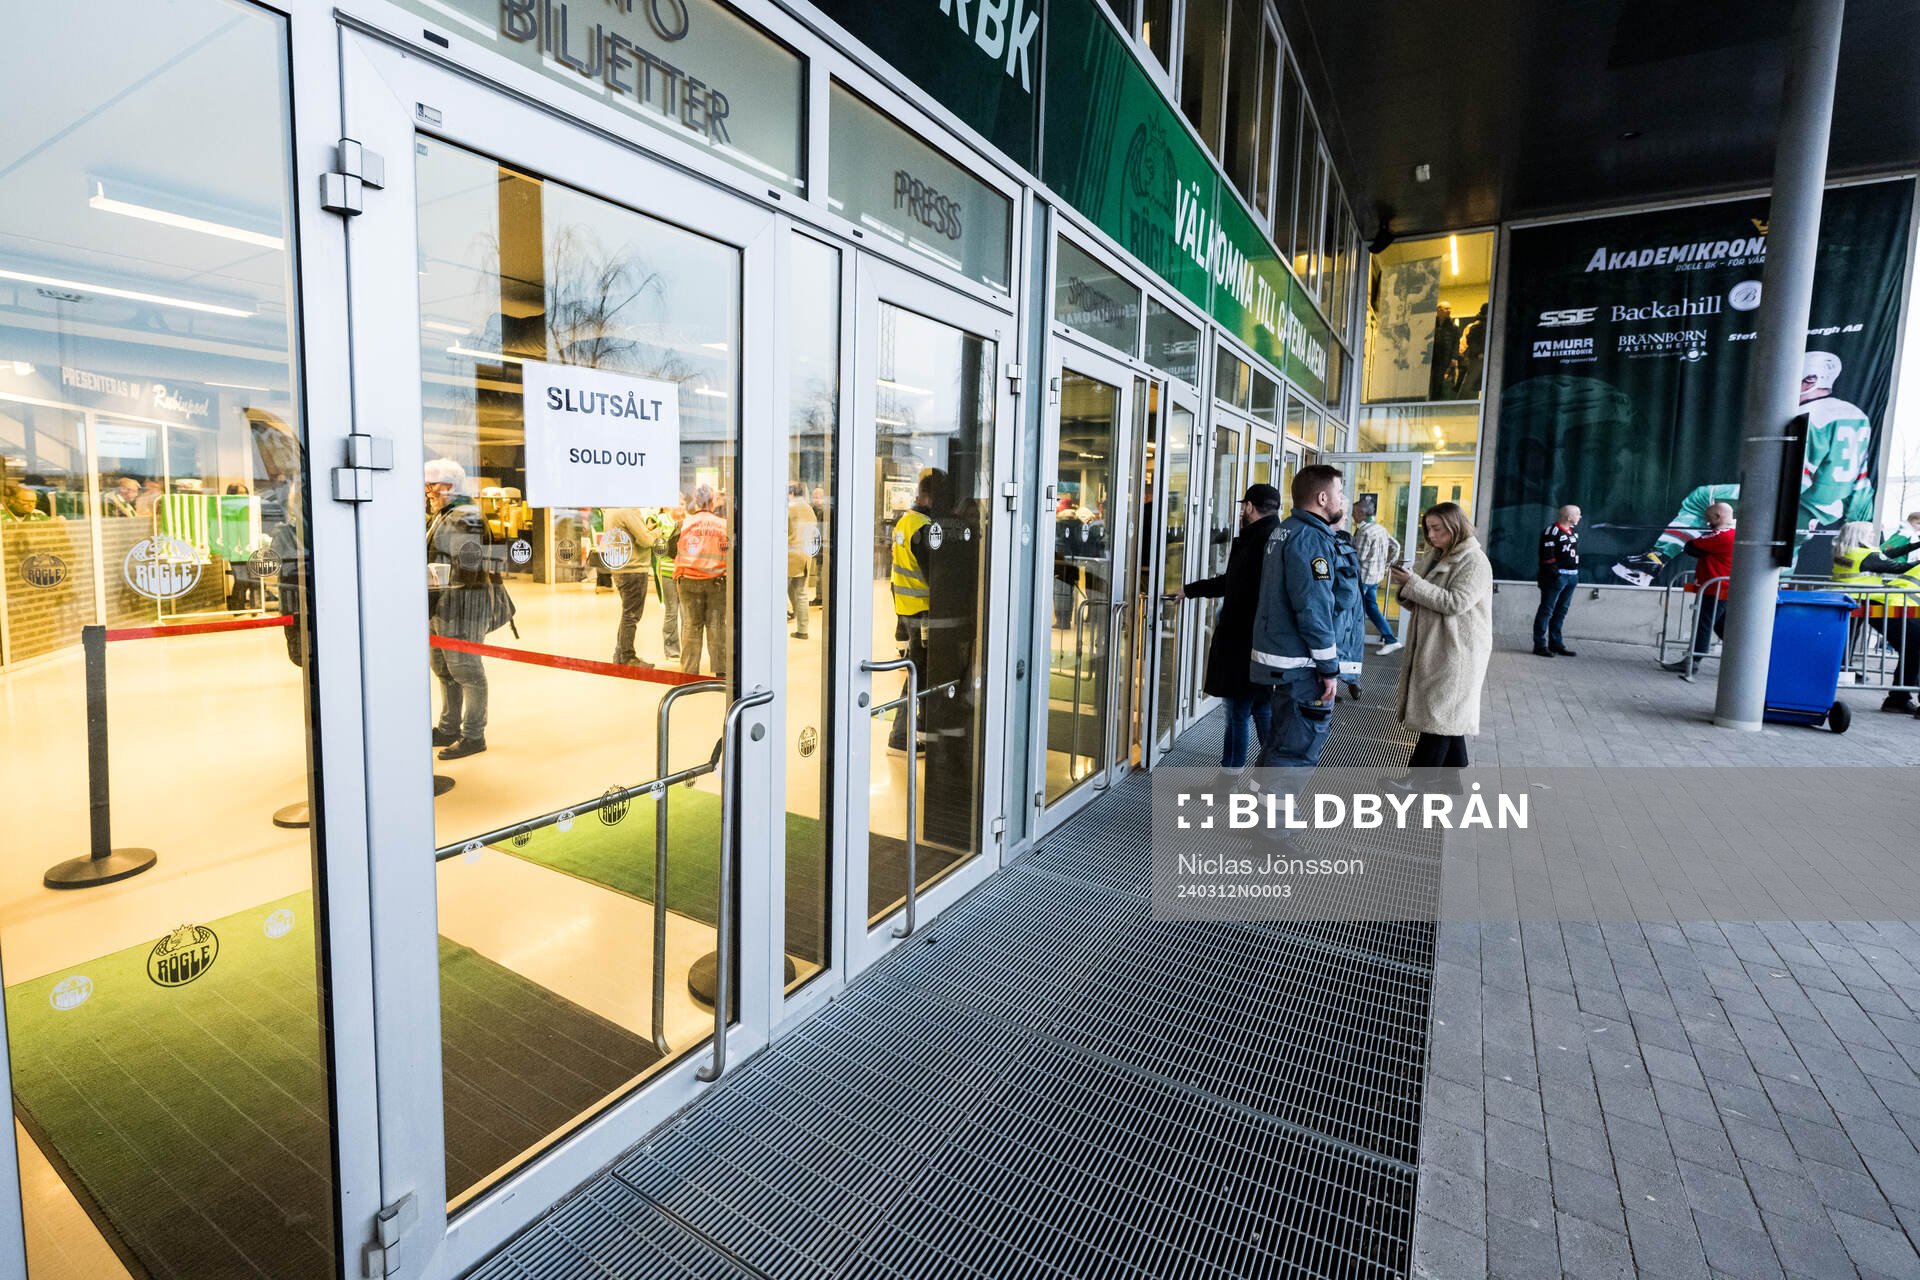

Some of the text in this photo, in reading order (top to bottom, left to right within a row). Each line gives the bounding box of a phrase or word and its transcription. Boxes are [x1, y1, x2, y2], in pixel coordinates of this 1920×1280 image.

[505, 0, 730, 143] BILJETTER
[896, 169, 961, 240] PRESS
[1585, 236, 1767, 272] AKADEMIKRON
[1538, 306, 1599, 326] SSE
[1611, 295, 1722, 322] Backahill
[1256, 275, 1276, 334] TILL
[1305, 335, 1327, 382] ARENA
[1552, 337, 1594, 350] MURR
[1728, 331, 1758, 341] Stef
[1552, 348, 1593, 357] ELEKTRONIK
[1617, 341, 1707, 353] FASTIGHETER
[62, 365, 128, 397] PRESENTERAS
[546, 386, 663, 422] SLUTSÅLT
[569, 447, 646, 466] SOLD OUT
[136, 561, 193, 595] RÖGLE
[157, 945, 210, 983] RÖGLE
